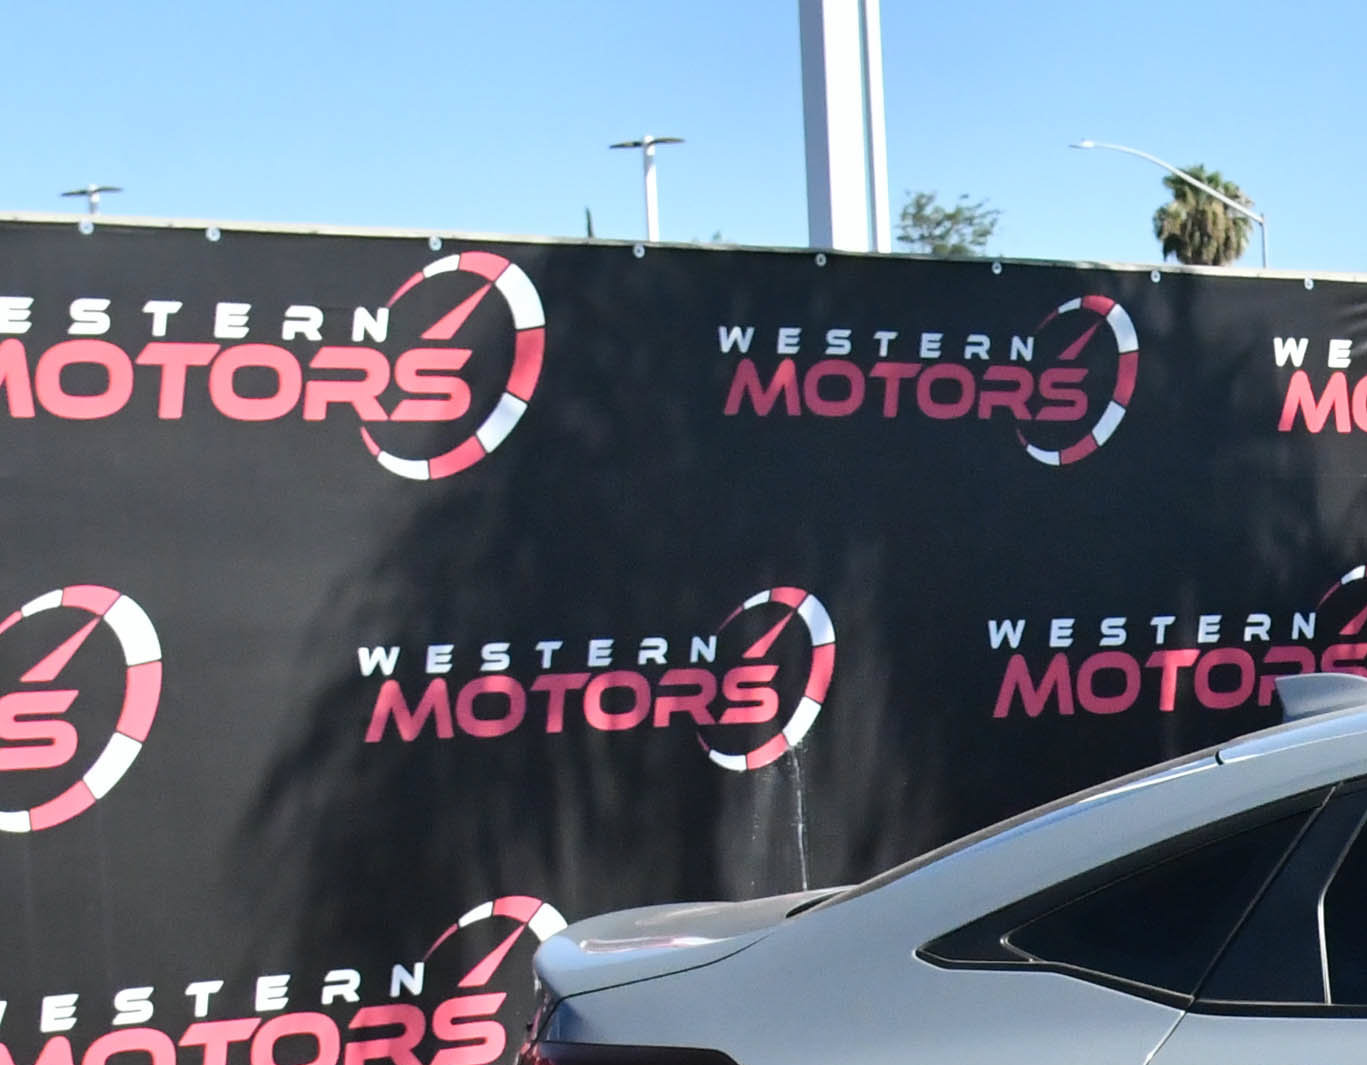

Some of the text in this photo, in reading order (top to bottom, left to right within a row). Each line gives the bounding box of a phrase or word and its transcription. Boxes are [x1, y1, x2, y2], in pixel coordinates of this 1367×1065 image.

[718, 326, 1034, 361] WESTERN
[0, 337, 473, 423] OTORS
[724, 357, 1089, 421] MOTORS
[357, 635, 718, 677] WESTERN
[988, 612, 1316, 649] WESTERN
[365, 663, 780, 744] MOTORS
[0, 961, 426, 1034] ESTERN
